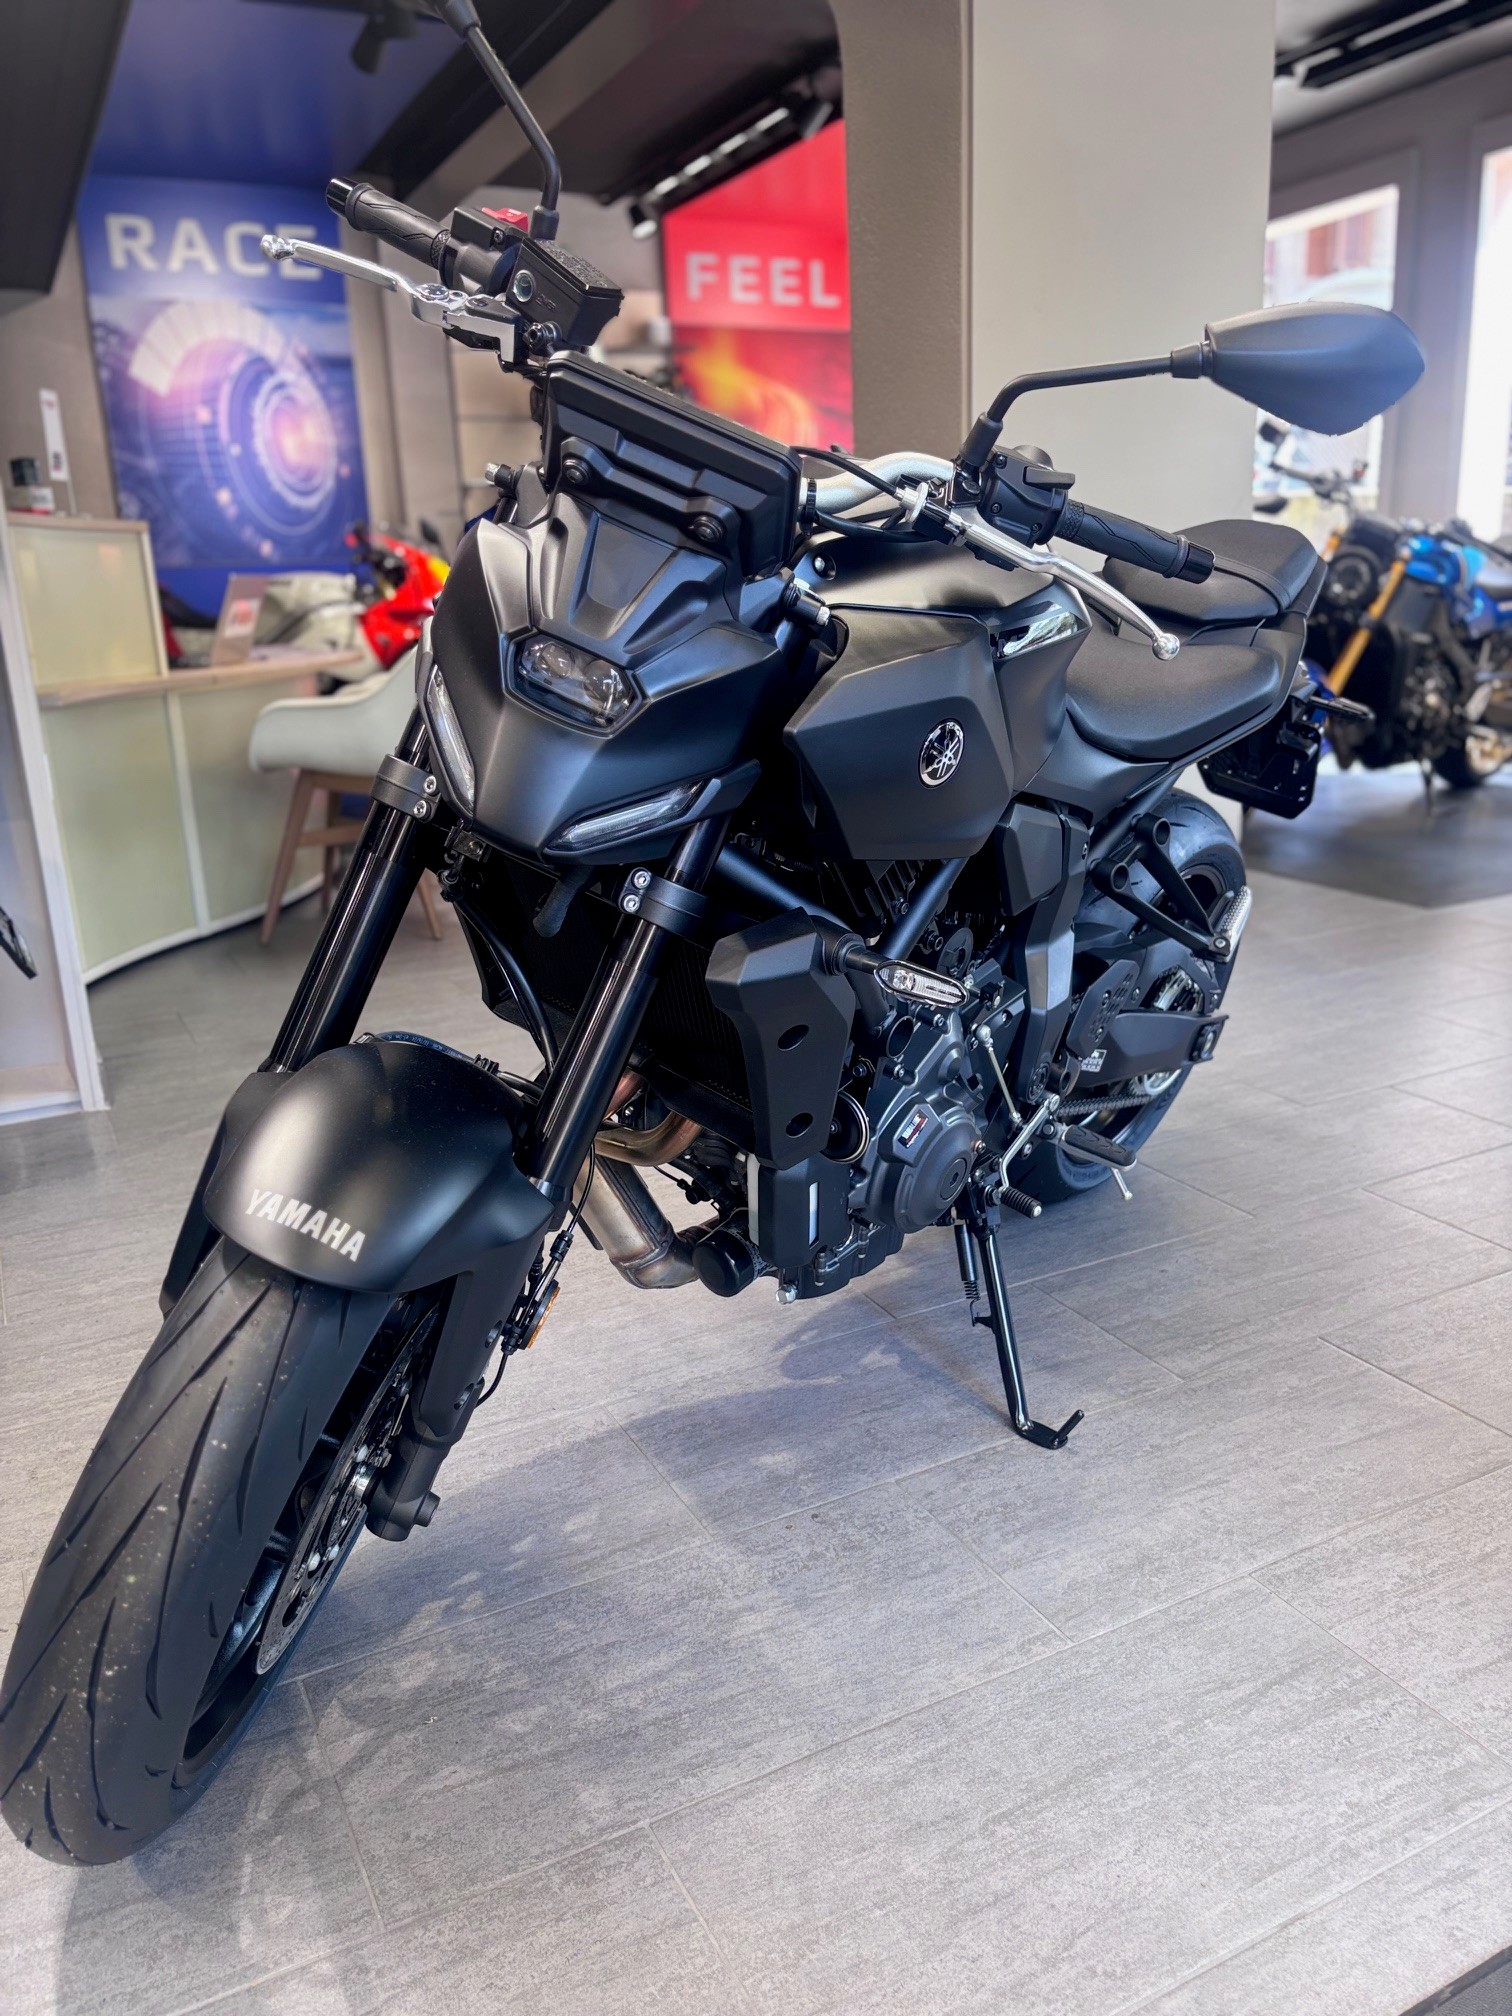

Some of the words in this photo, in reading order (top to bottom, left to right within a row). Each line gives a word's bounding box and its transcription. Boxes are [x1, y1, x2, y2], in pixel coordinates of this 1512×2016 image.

[105, 212, 323, 282] RACE
[684, 252, 842, 308] FEEL
[244, 1188, 366, 1263] YAMAHA
